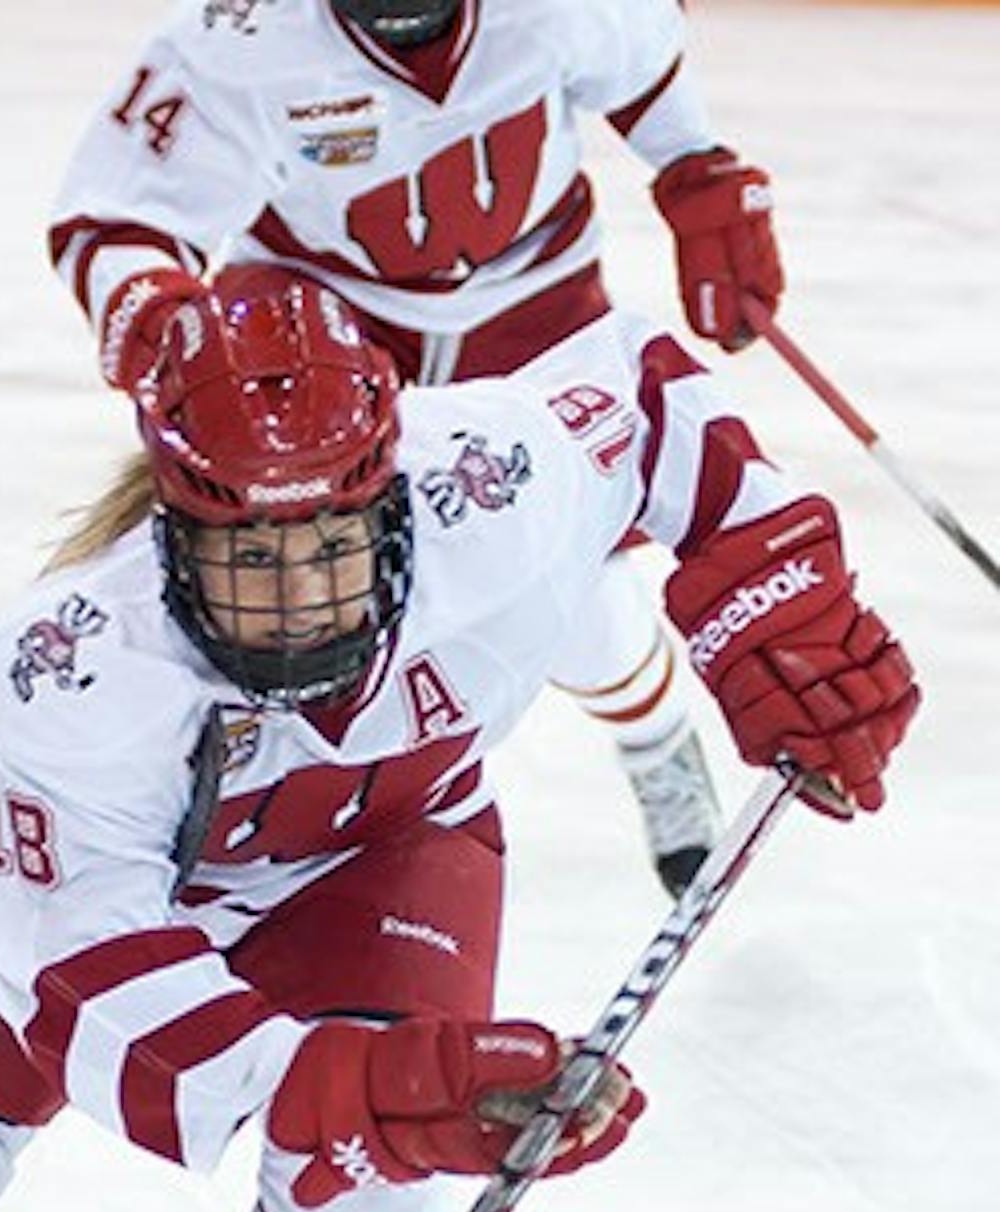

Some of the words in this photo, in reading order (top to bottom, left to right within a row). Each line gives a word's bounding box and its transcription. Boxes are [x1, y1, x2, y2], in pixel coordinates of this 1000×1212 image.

[111, 66, 188, 158] 14
[346, 98, 551, 280] W
[689, 554, 826, 671] Reebok
[404, 650, 470, 748] A
